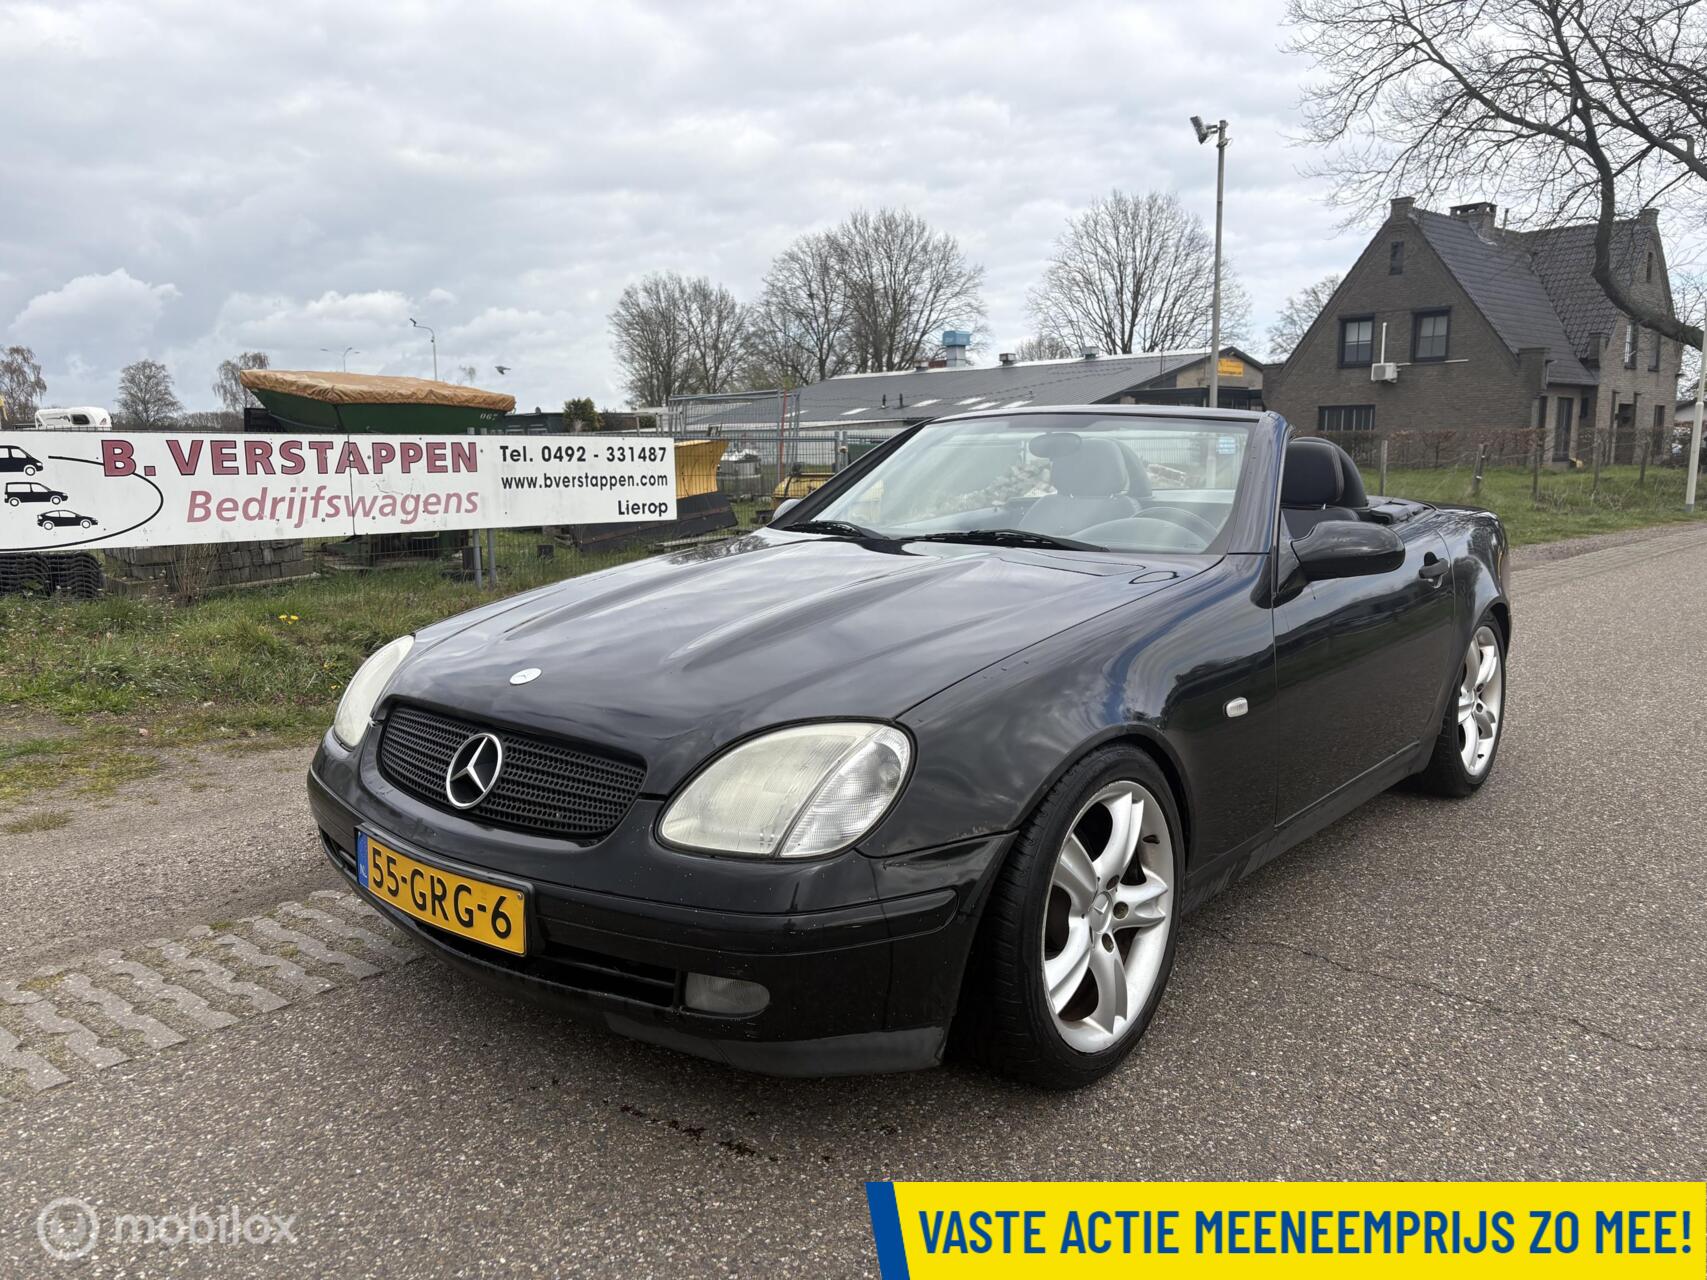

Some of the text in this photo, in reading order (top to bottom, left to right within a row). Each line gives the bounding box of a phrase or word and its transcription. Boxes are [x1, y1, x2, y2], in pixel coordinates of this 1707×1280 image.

[101, 439, 478, 477] B. VERSTAPPEN
[500, 445, 533, 462] Tel.
[541, 446, 586, 462] 0492
[606, 447, 667, 462] 331487
[501, 472, 668, 491] www.bverstappen.com
[187, 485, 479, 529] Bedrijfswagens
[618, 500, 668, 517] Lierop
[371, 846, 512, 940] 55-GRG-6
